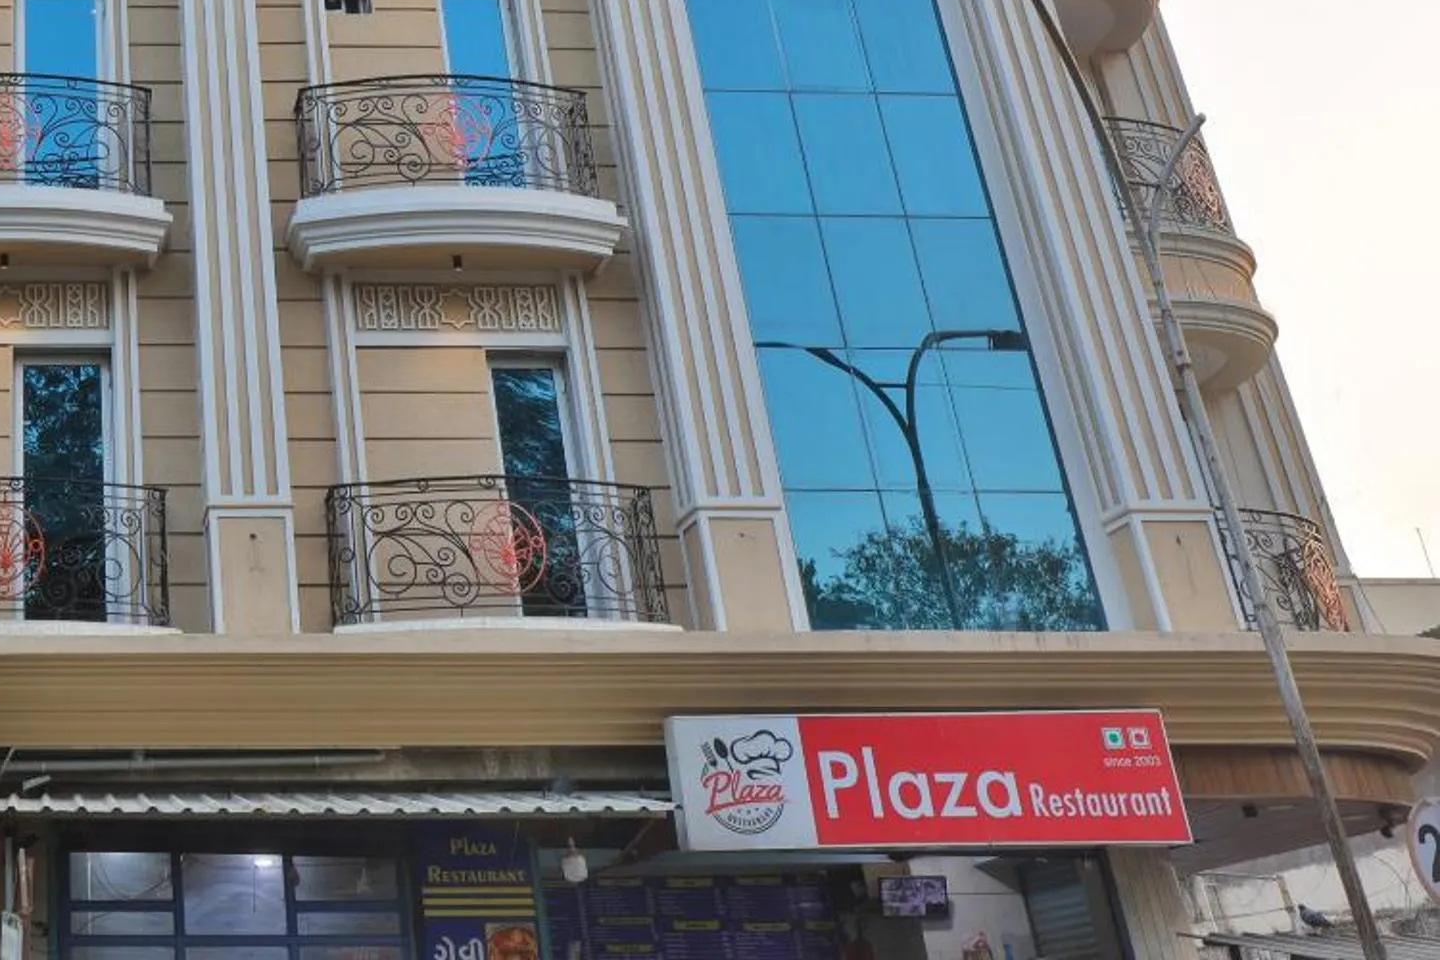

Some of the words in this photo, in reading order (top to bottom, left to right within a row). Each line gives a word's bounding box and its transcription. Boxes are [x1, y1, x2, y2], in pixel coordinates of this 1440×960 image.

[1103, 757, 1132, 768] since
[702, 769, 785, 815] Plaza
[817, 746, 1022, 819] Plaza
[1029, 782, 1173, 818] Restaurant
[427, 865, 528, 883] RESTAURANT
